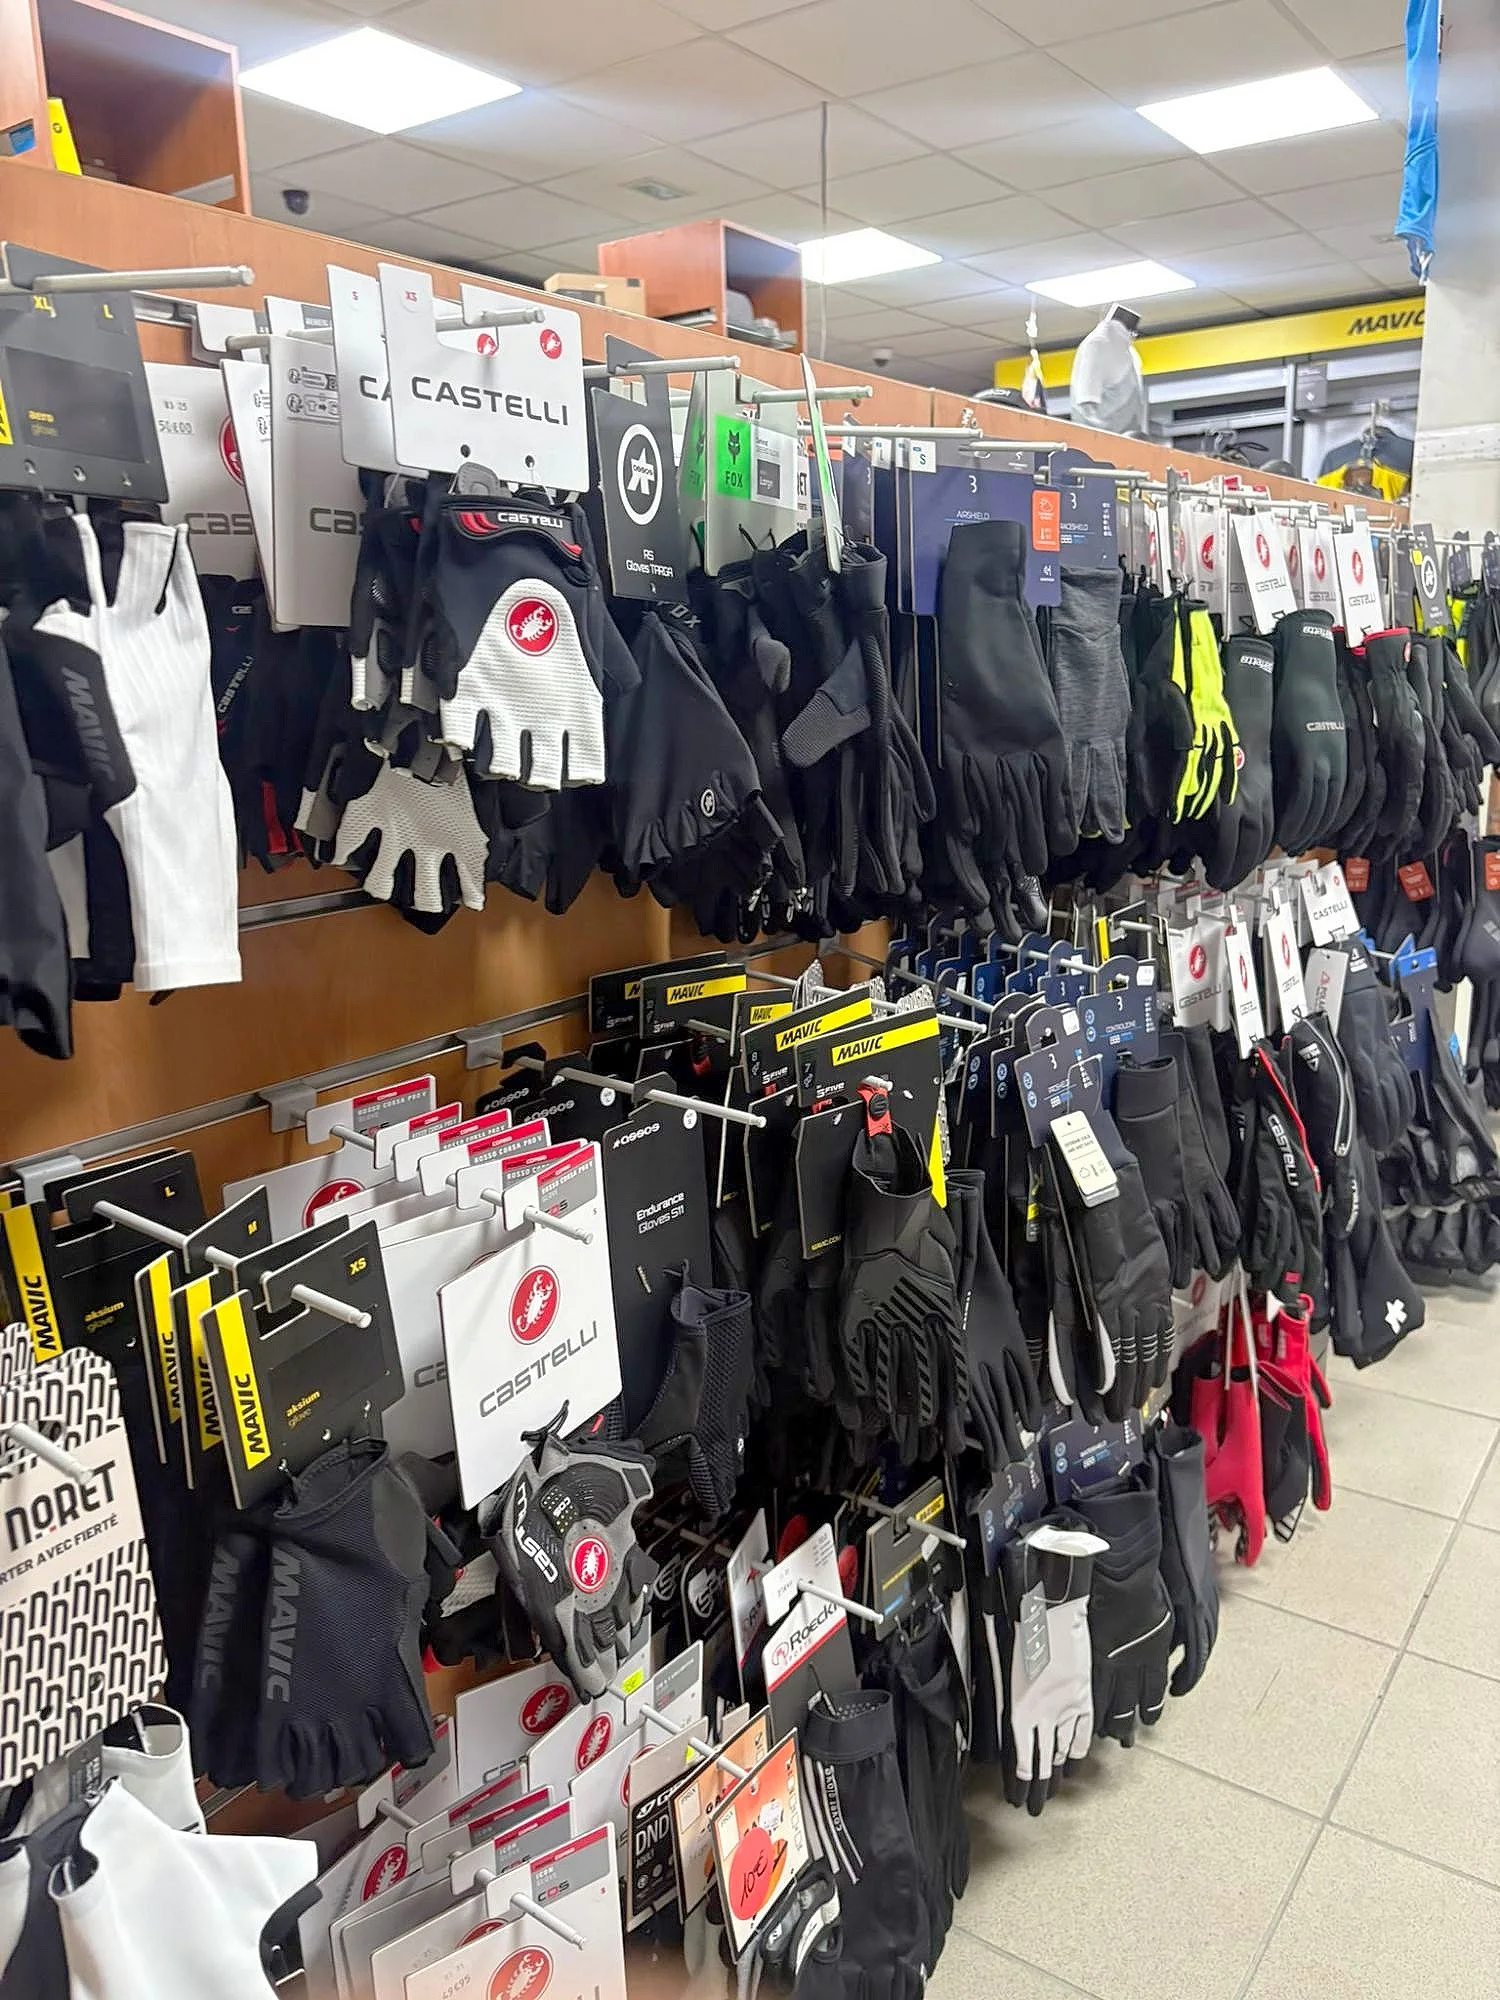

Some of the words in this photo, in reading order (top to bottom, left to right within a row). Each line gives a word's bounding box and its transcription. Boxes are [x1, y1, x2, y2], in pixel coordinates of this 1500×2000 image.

[411, 376, 568, 426] CASTELLI
[919, 451, 927, 465] S
[725, 470, 743, 488] FOX
[1313, 900, 1348, 920] CASTELLI
[670, 984, 705, 1002] MAVIC
[780, 1018, 822, 1048] MAVIC
[751, 1051, 758, 1062] 8
[837, 1036, 884, 1061] MAVIC
[804, 1063, 812, 1073] 7
[165, 1186, 175, 1198] L
[636, 1191, 685, 1222] Endurance
[638, 1212, 671, 1235] Gloves
[348, 1254, 367, 1277] XS
[22, 1275, 58, 1352] MAVIC
[83, 1299, 125, 1323] aksium
[234, 1372, 266, 1455] MAVIC
[286, 1390, 320, 1418] aksium
[36, 1537, 73, 1566] AVEC
[74, 1512, 119, 1545] FIERTÉ
[200, 1543, 241, 1690] MAVIC
[266, 1547, 303, 1704] MAVIC
[636, 1813, 670, 1857] DND
